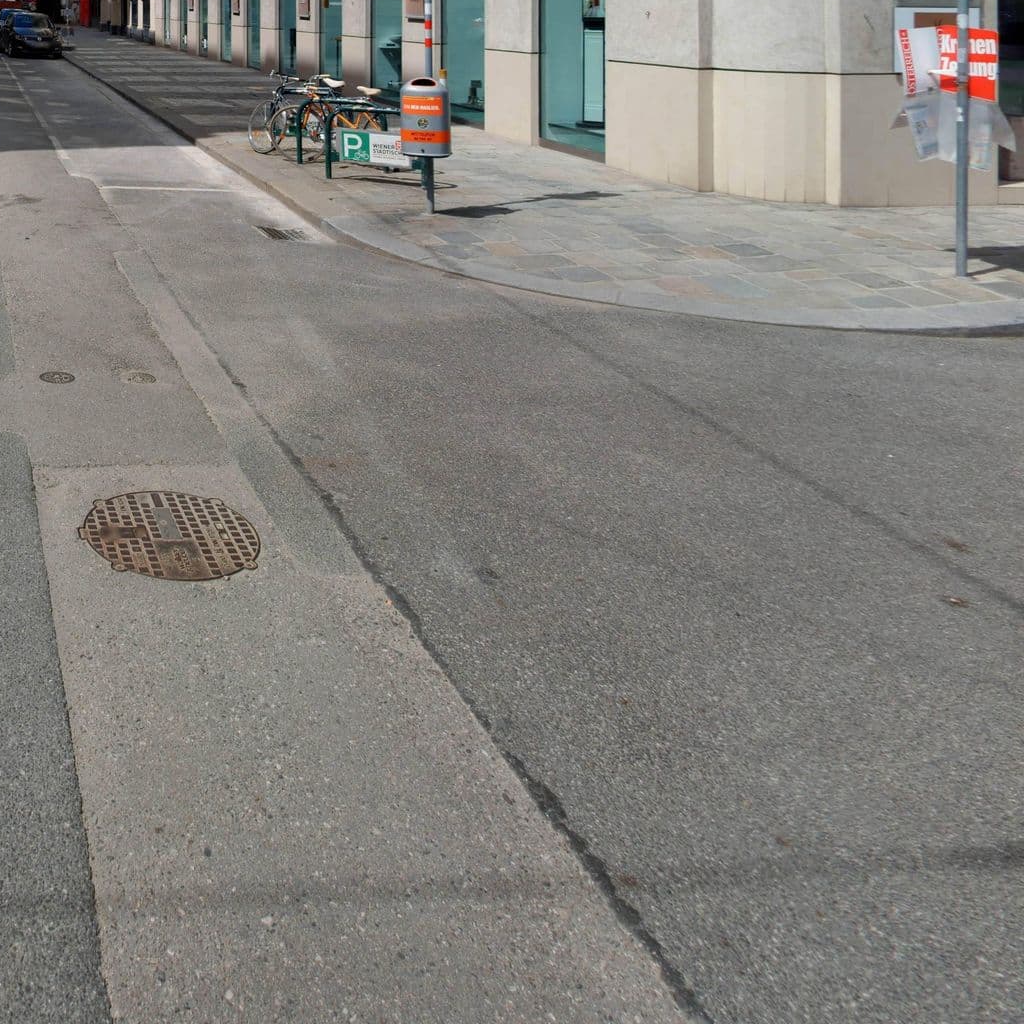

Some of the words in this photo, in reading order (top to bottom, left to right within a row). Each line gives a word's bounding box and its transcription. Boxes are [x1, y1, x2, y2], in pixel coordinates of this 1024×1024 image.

[940, 34, 996, 55] Krnen
[940, 57, 997, 81] Zeung
[343, 133, 363, 158] P
